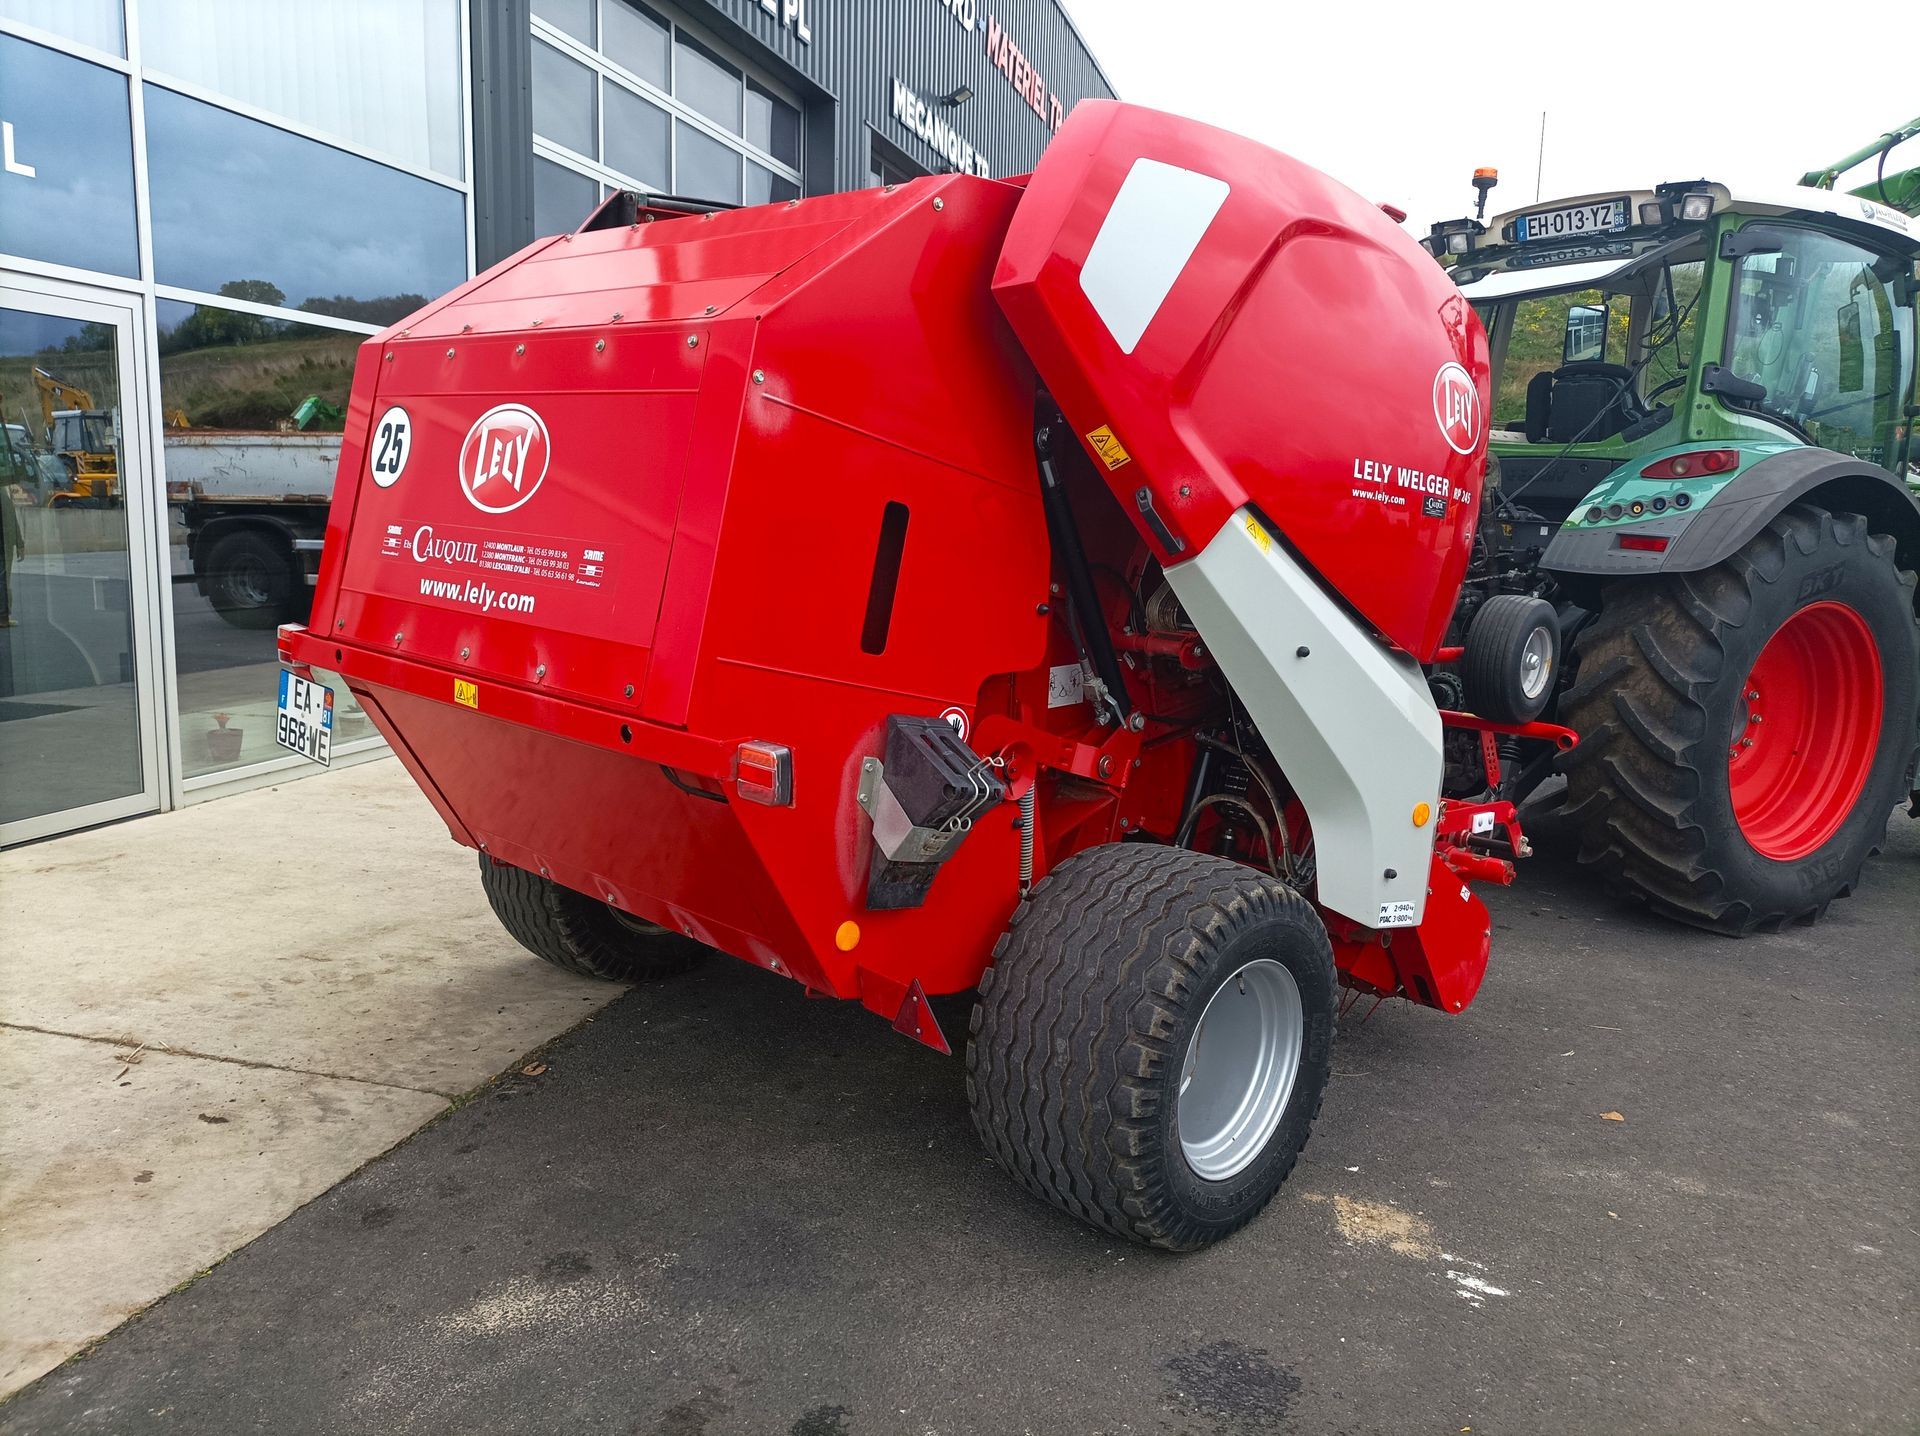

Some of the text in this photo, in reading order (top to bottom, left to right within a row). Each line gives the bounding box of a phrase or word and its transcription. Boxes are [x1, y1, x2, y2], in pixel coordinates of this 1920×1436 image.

[986, 14, 1047, 122] MATERIEL
[893, 78, 974, 174] MECANIQUE
[2, 121, 37, 178] L
[1528, 205, 1613, 238] EH-013-YZ
[1614, 214, 1624, 225] 86
[1444, 375, 1473, 440] LELY
[375, 422, 406, 475] 25
[471, 424, 535, 493] LELY
[1352, 488, 1406, 505] www.lely.com
[1353, 458, 1393, 484] LELY
[1397, 466, 1450, 497] WELGER
[412, 525, 478, 565] CAUQUIL
[494, 552, 525, 564] MONTFRANC
[496, 542, 524, 553] MONTLAUR
[492, 561, 513, 572] LESCURE
[420, 578, 535, 613] www.lely.com
[322, 709, 332, 725] 81
[278, 712, 329, 763] 968-WE
